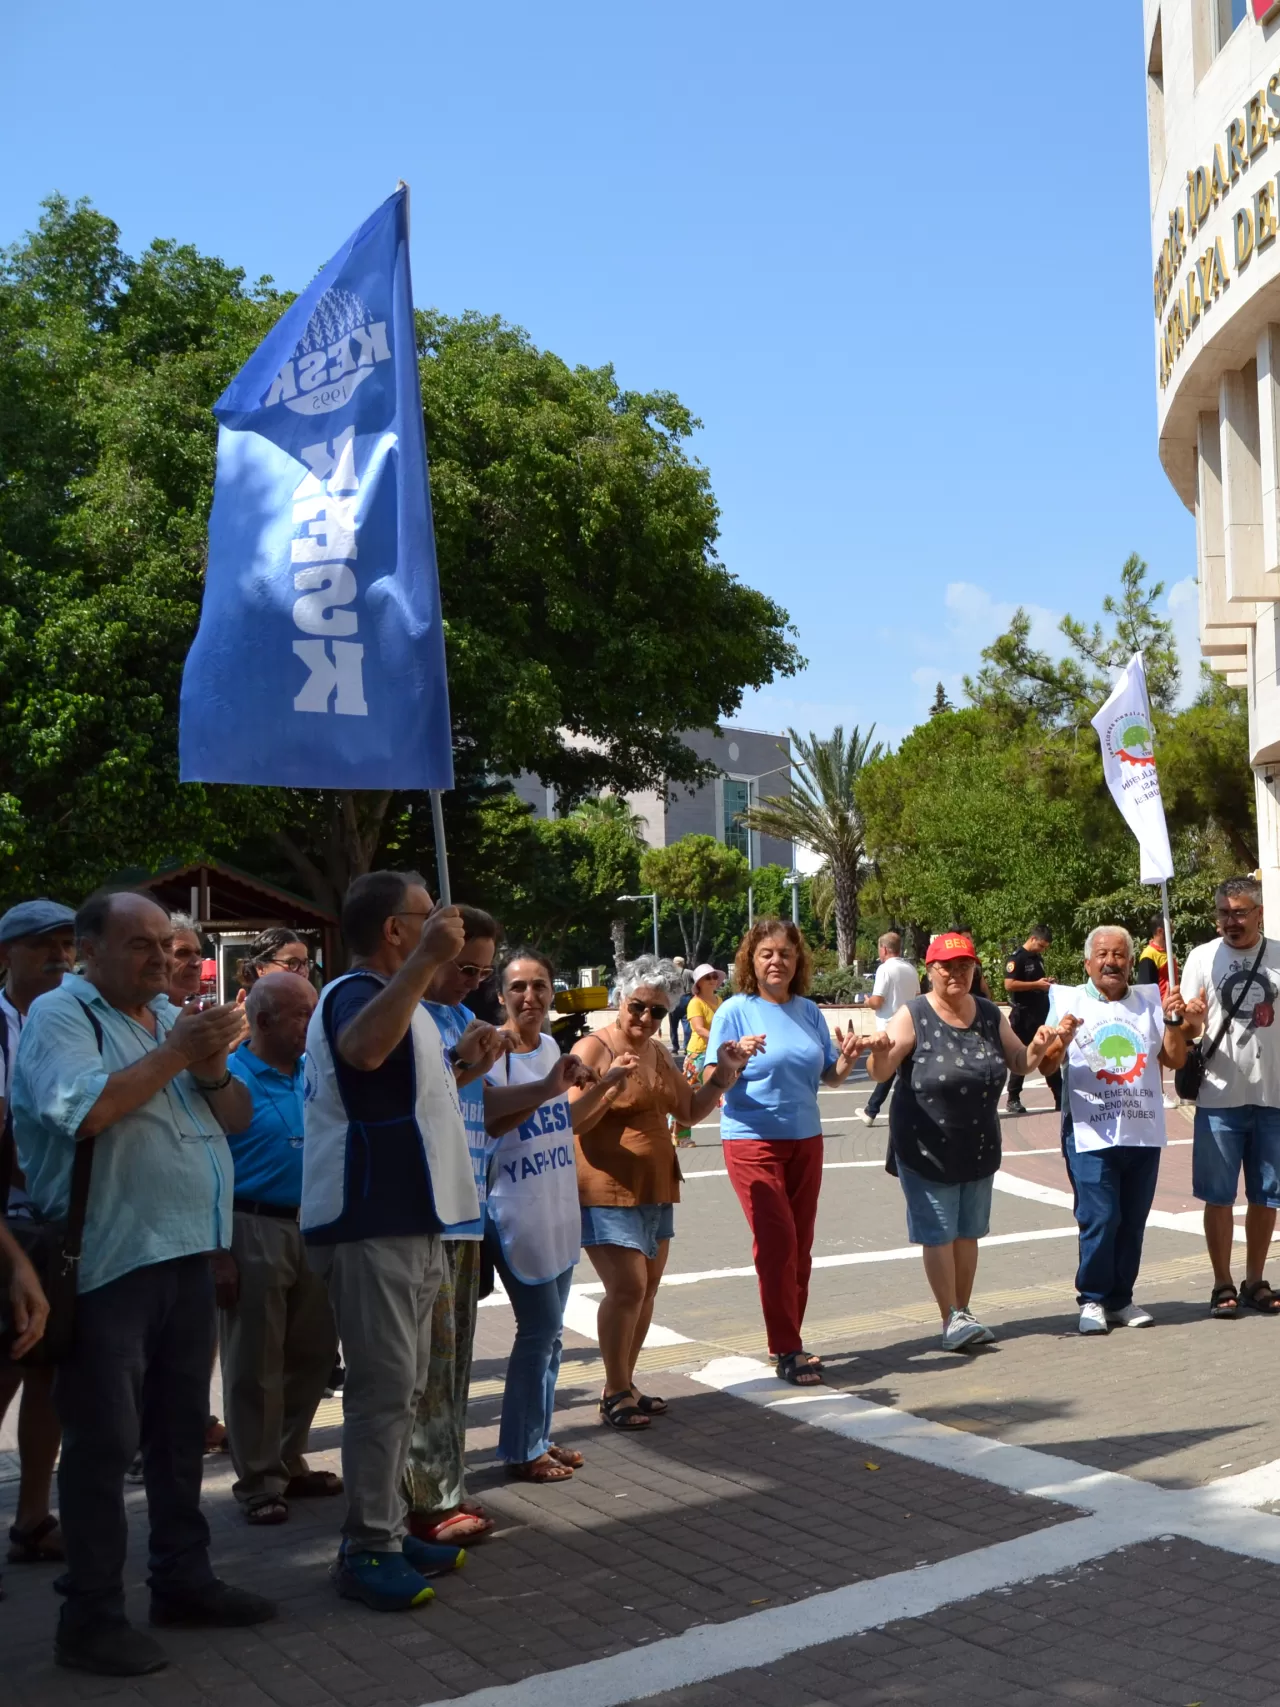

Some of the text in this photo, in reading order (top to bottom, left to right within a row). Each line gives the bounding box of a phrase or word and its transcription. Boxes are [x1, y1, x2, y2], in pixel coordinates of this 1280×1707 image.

[1160, 236, 1231, 389] ANTALYA
[944, 938, 968, 949] BES
[1099, 1097, 1141, 1112] SENDİKASI
[1089, 1109, 1156, 1123] ANTALYA ŞUBESİ
[503, 1145, 572, 1184] YAPI-YOL
